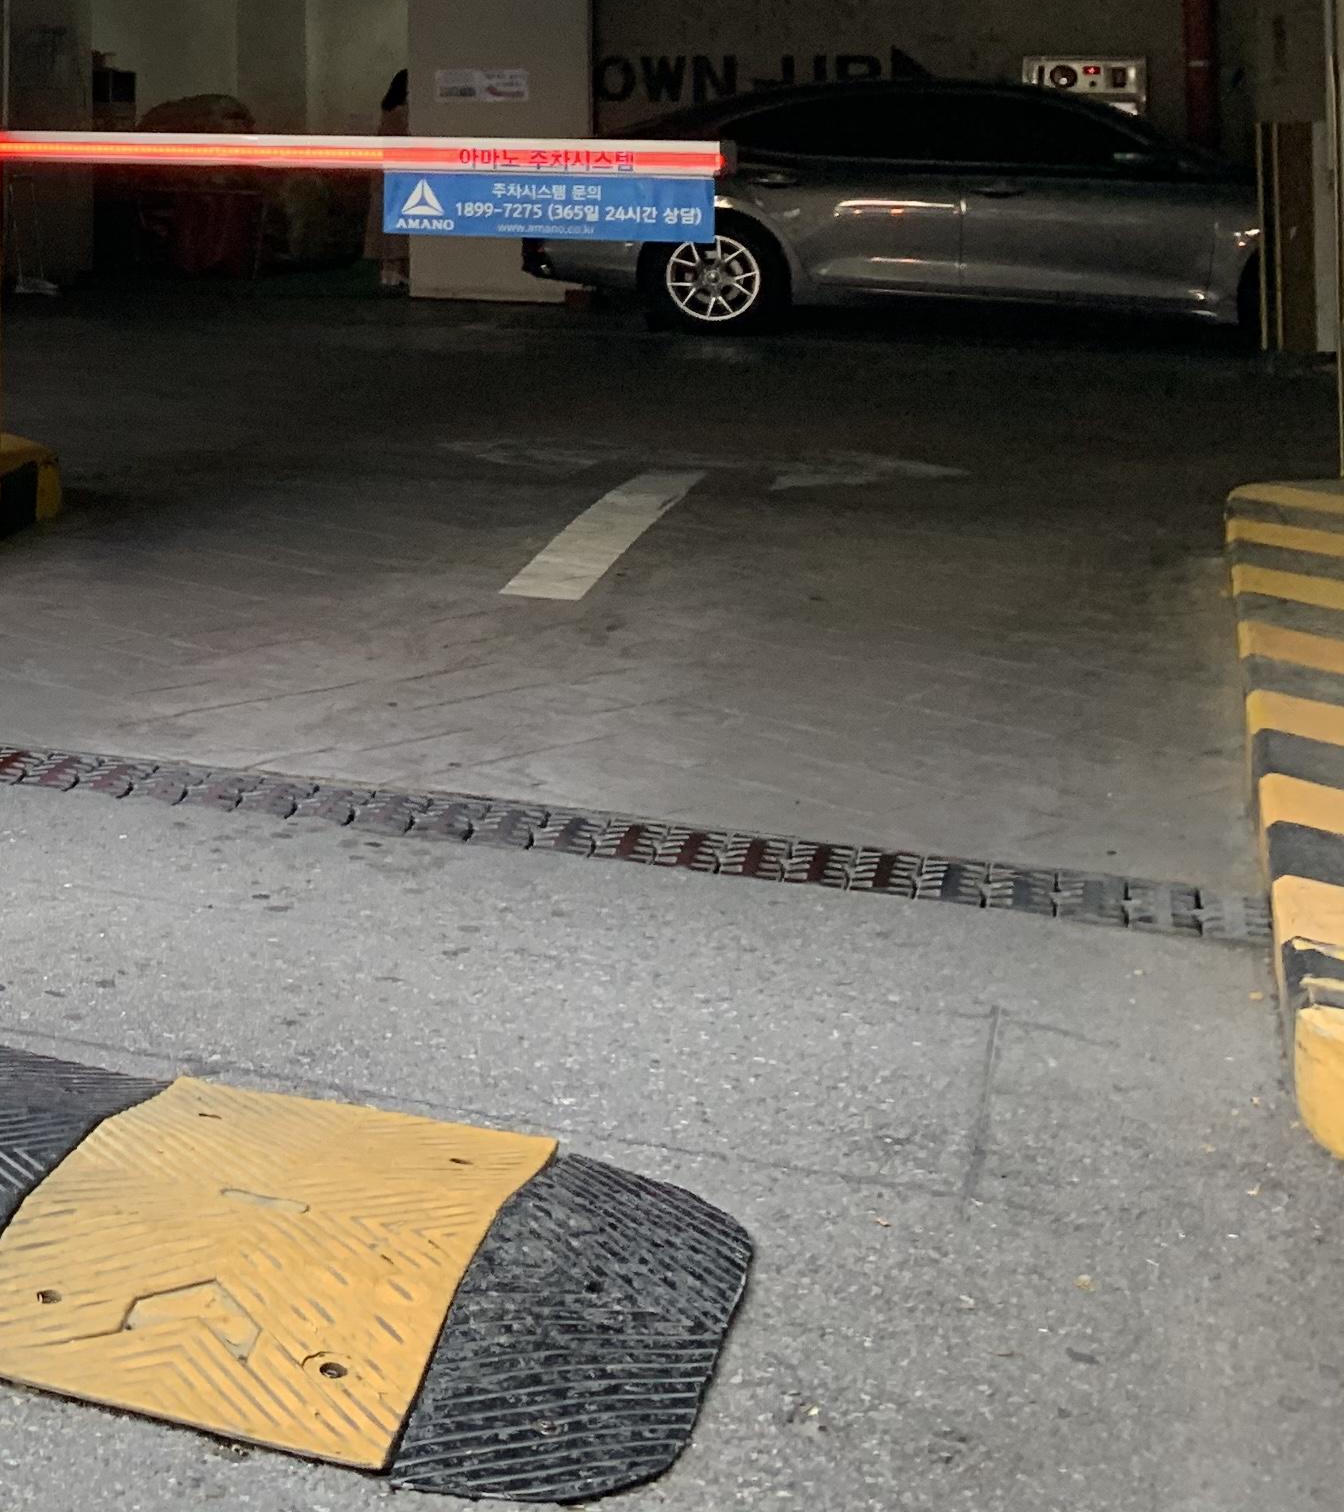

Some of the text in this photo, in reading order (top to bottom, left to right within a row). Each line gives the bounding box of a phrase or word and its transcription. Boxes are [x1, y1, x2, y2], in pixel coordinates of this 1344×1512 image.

[459, 148, 635, 172] 아마노 주차시스템
[492, 183, 602, 202] 주차시스템 문의
[455, 201, 702, 226] 1899-7275 (365일 24시간 상담)
[395, 218, 454, 232] AMANO
[497, 222, 596, 236] www.amano.co.kr
